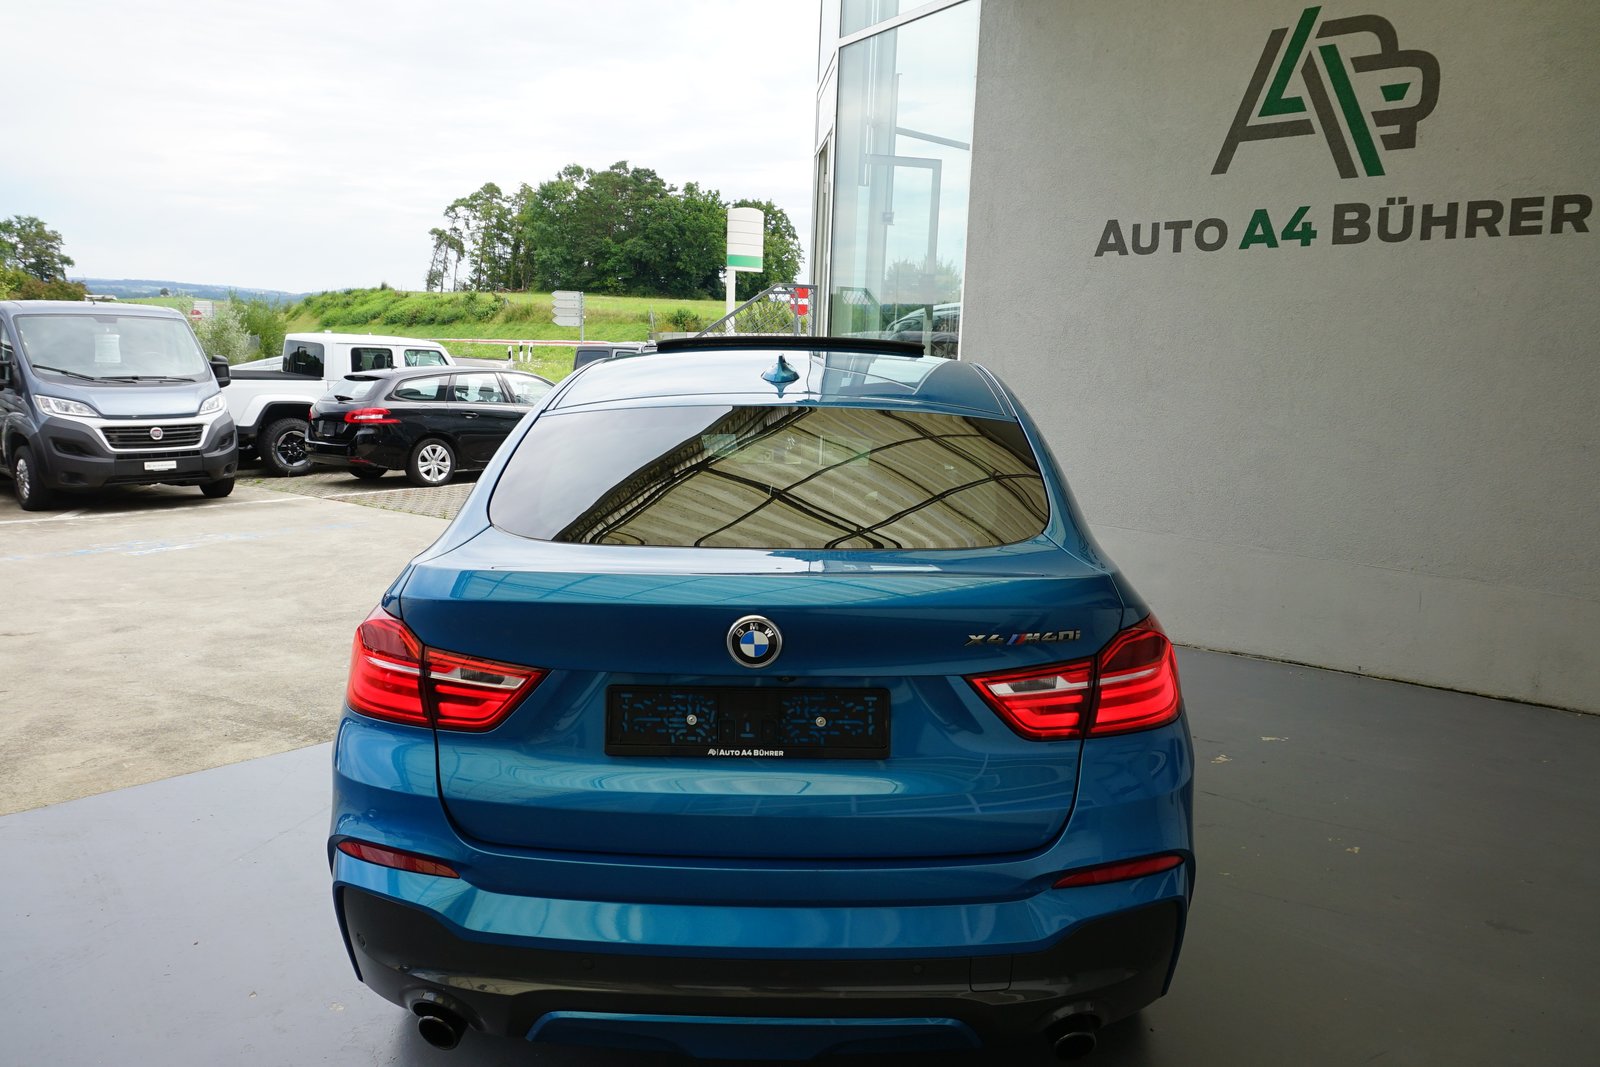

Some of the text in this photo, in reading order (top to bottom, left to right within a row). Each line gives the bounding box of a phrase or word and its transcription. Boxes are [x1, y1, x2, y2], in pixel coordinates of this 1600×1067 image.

[1094, 193, 1593, 258] AUTO A4 BÜHRER
[735, 622, 775, 638] BMW
[964, 634, 1004, 646] X4
[719, 748, 740, 756] AUTO
[741, 748, 752, 756] A4
[753, 748, 784, 757] BÜHRER
